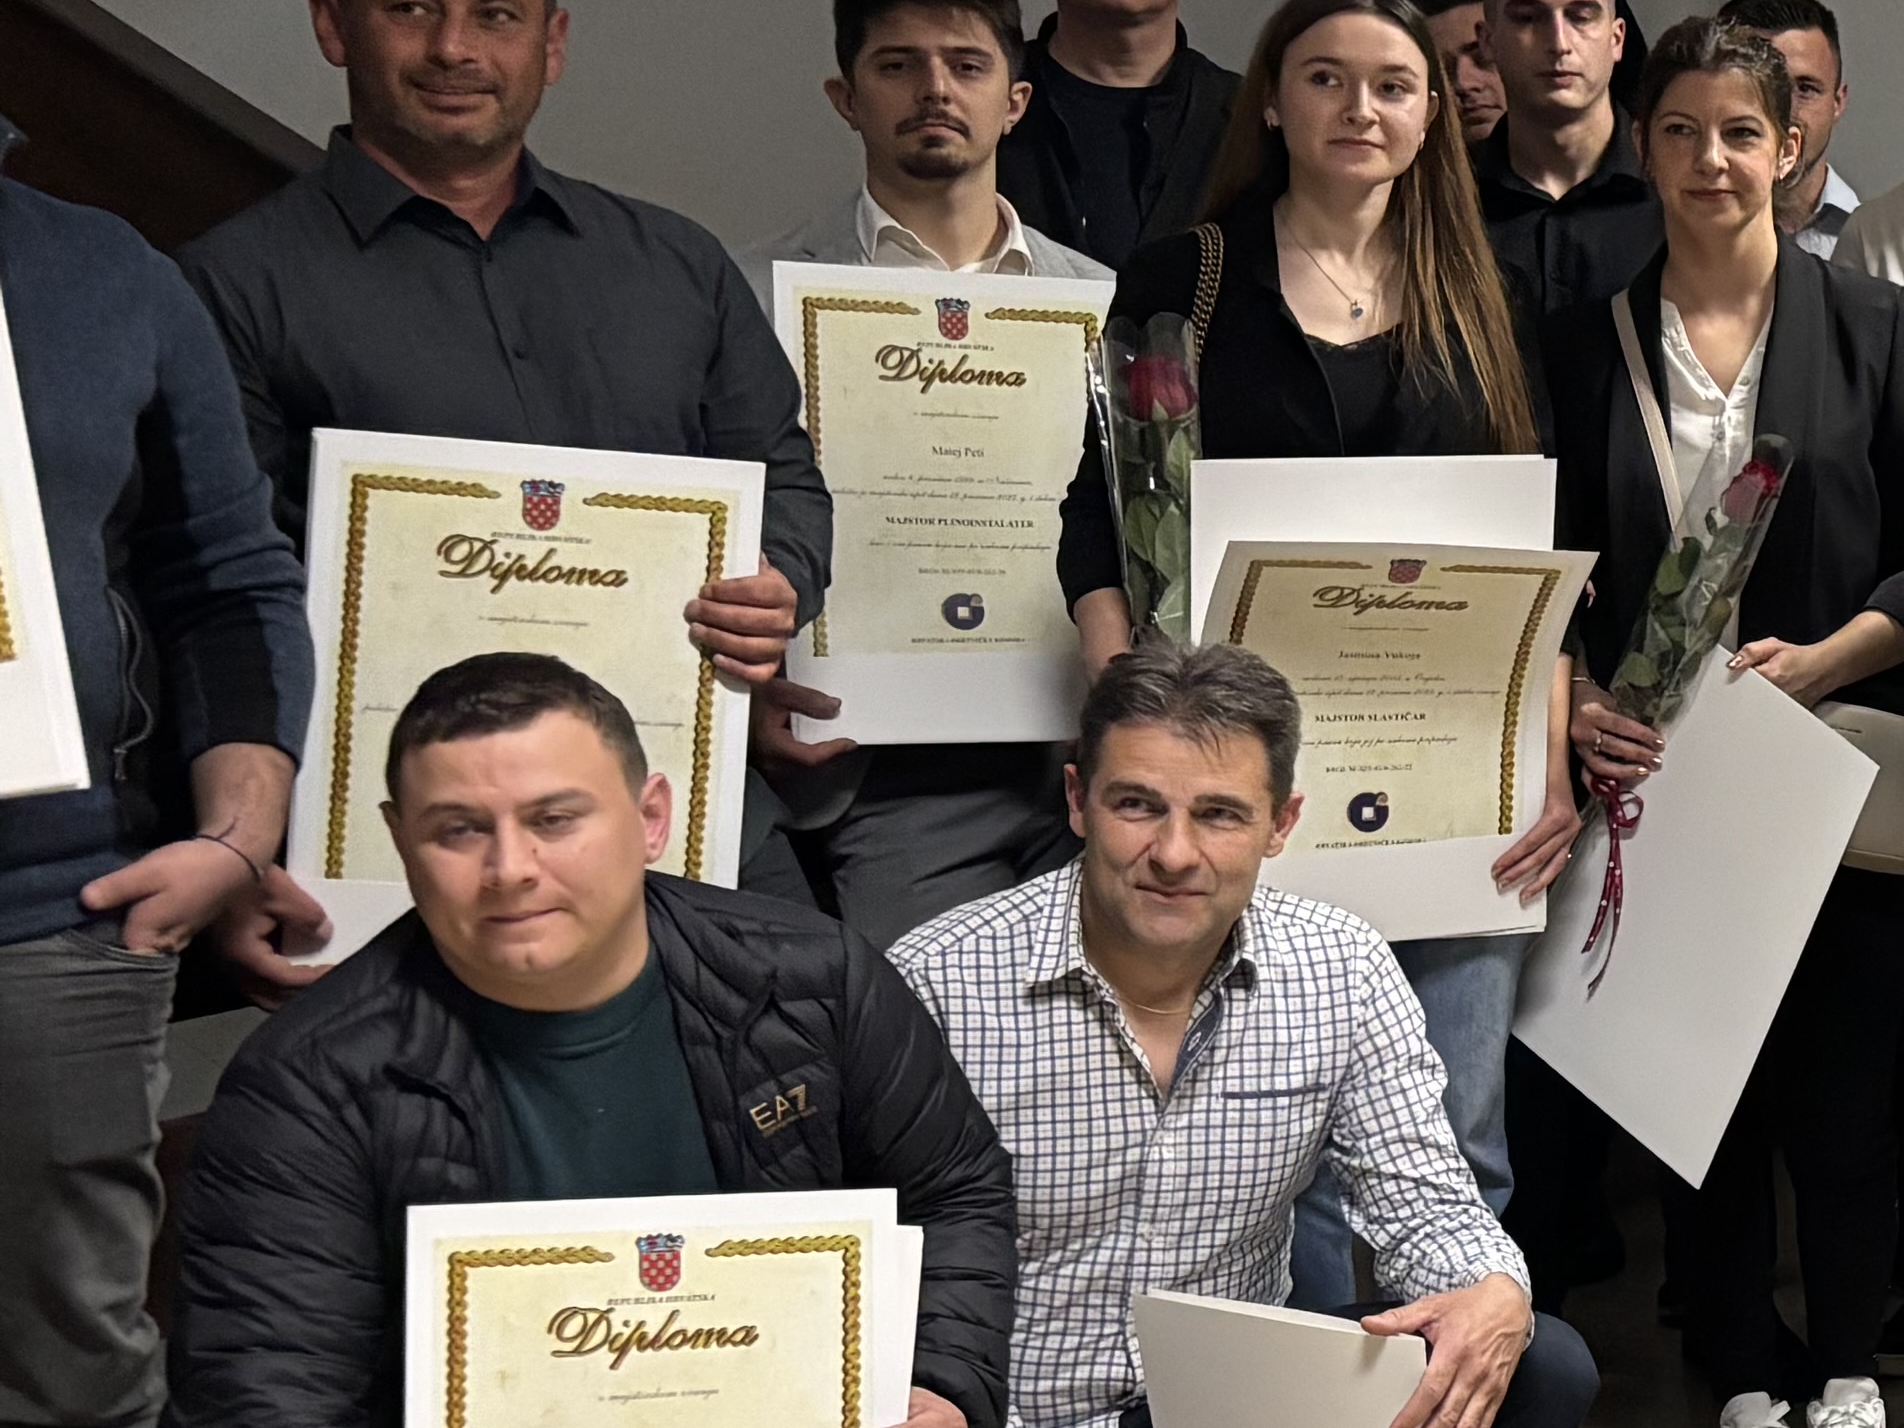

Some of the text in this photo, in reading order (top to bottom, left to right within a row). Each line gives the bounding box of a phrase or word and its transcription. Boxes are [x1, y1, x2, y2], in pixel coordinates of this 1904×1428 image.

[875, 344, 1027, 394] Diploma
[436, 533, 629, 594] Diploma
[1312, 585, 1470, 616] Diploma
[749, 1083, 806, 1130] EA7
[547, 1306, 760, 1371] Diploma
